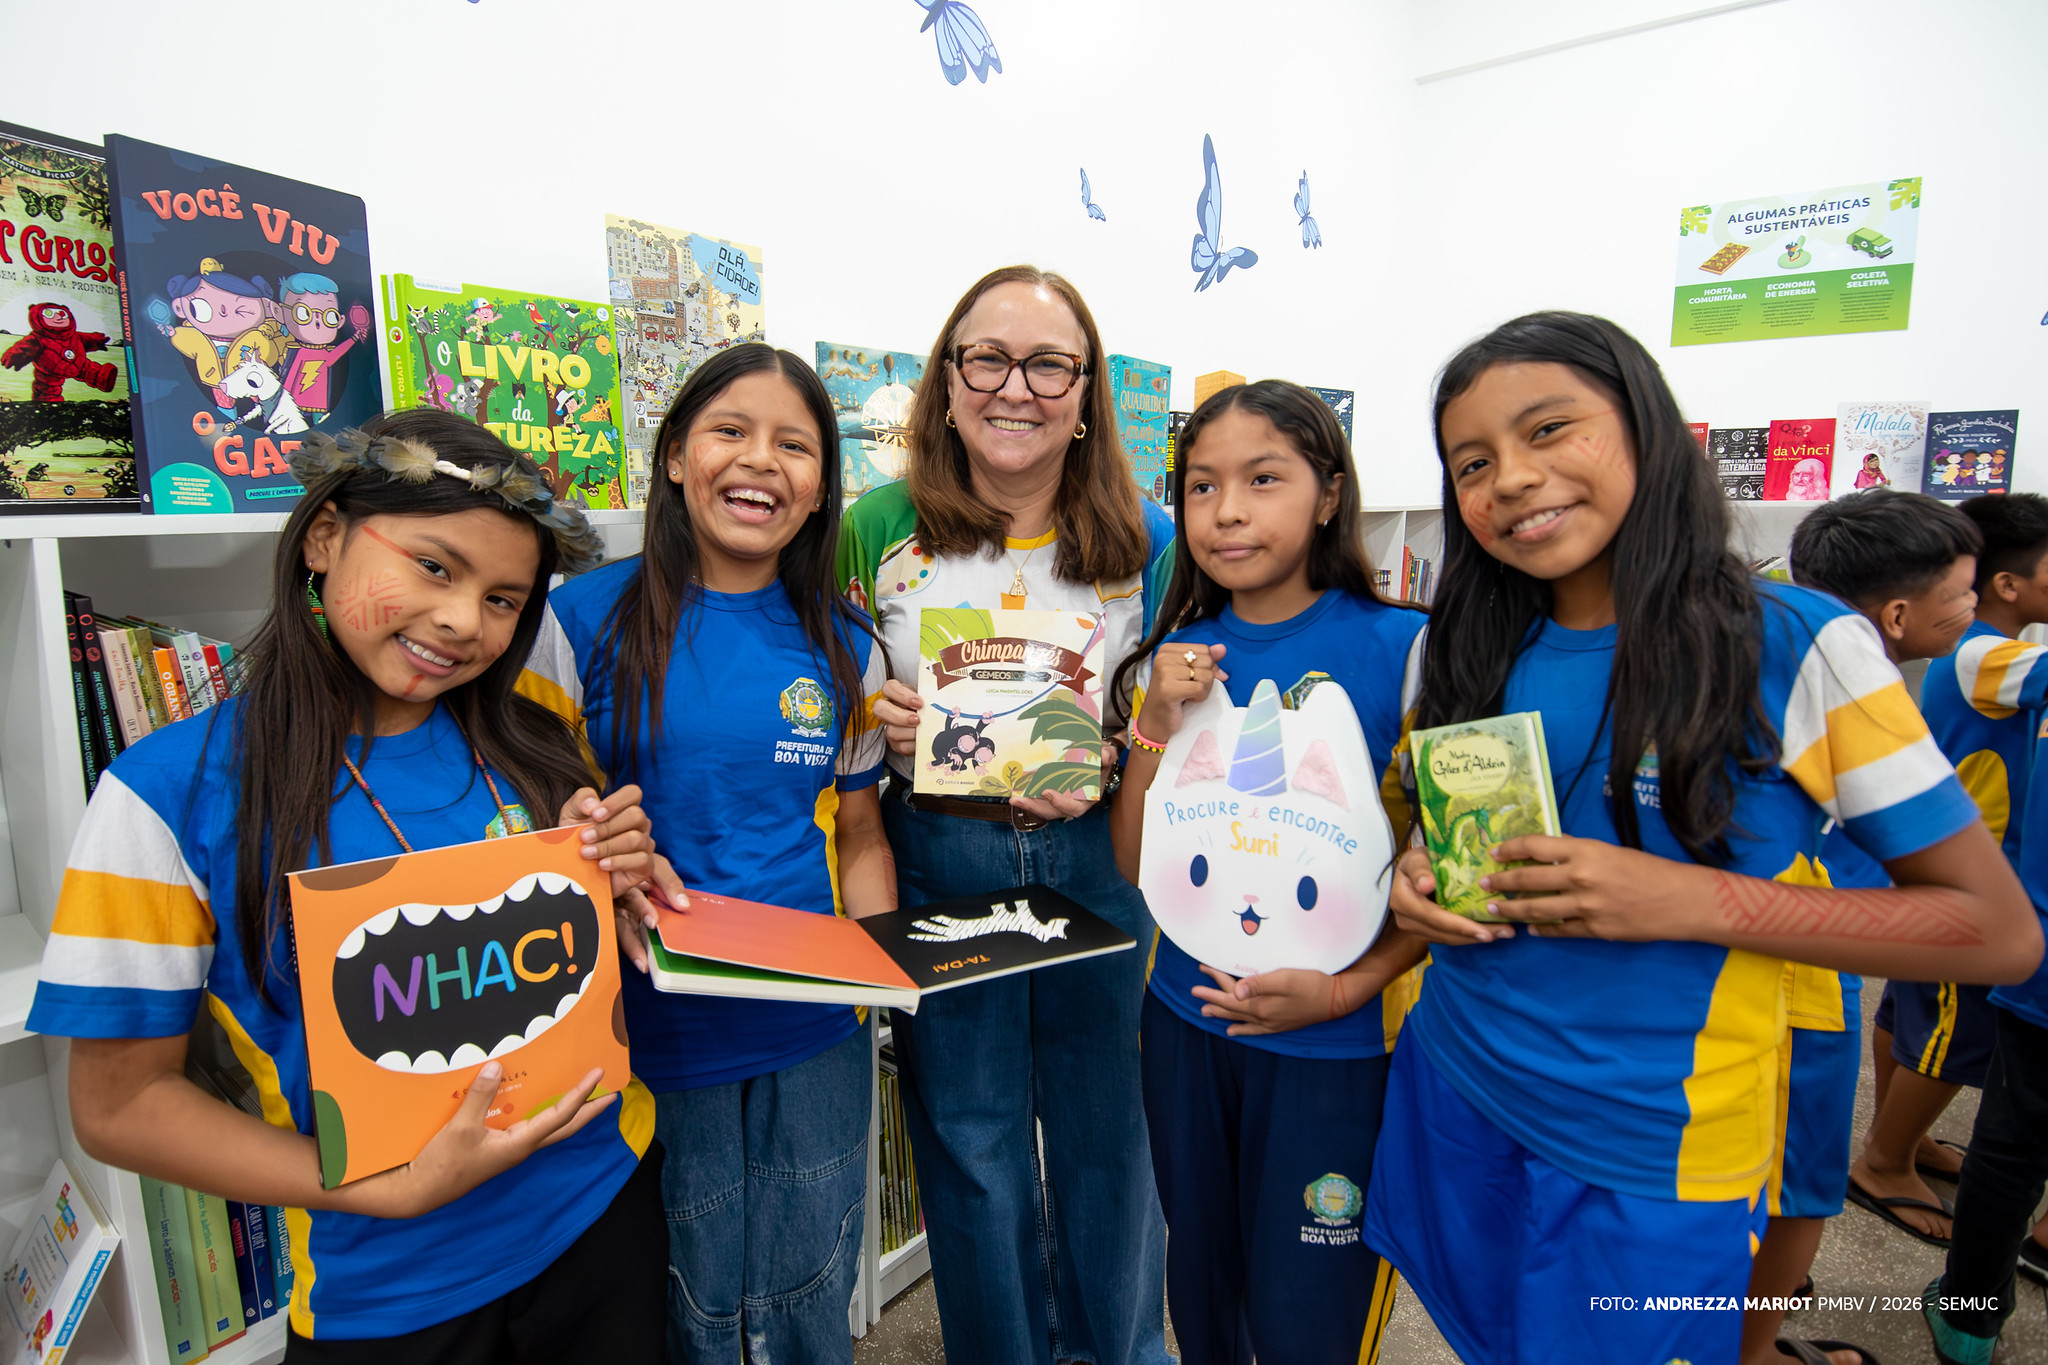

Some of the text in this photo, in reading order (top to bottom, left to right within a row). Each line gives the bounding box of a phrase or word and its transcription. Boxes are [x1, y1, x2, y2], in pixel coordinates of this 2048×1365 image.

[2, 155, 76, 179] MATTHIAS PICARD
[1727, 196, 1871, 225] ALGUMAS PRÁTICAS
[142, 183, 341, 266] VOCÊ VIU
[1744, 212, 1850, 236] SUSTENTÁVEIS
[718, 246, 746, 272] OLÁ,
[35, 275, 67, 289] SELVA
[716, 262, 759, 297] CIDADE!
[1767, 280, 1816, 291] ECONOMIA
[1845, 278, 1890, 289] SELETIVA
[1850, 270, 1887, 280] COLETA
[1688, 292, 1748, 304] COMUNITÁRIA
[1703, 286, 1733, 296] HORTA
[1778, 287, 1817, 297] ENERGIA
[437, 340, 452, 366] O
[457, 341, 592, 389] LIVRO
[395, 361, 405, 393] LIVRO
[511, 399, 534, 423] da
[1120, 389, 1169, 414] QUADRIBOL
[192, 411, 214, 436] O
[1125, 424, 1154, 441] ATRAVÉS
[1855, 410, 1912, 438] Malala
[1773, 446, 1788, 456] da
[1718, 462, 1767, 472] MATEMÁTICA
[961, 638, 1063, 667] Chimpaés
[162, 671, 171, 680] O
[95, 682, 107, 711] CURIOSO
[103, 715, 114, 740] VIAGEM
[774, 751, 830, 767] BOA VISTA
[775, 740, 834, 755] PREFEITURA DE
[1230, 820, 1280, 857] Suni
[373, 921, 578, 1023] NHAC!
[1301, 1225, 1360, 1236] PREFEITURA
[1301, 1232, 1359, 1246] BOA VISTA
